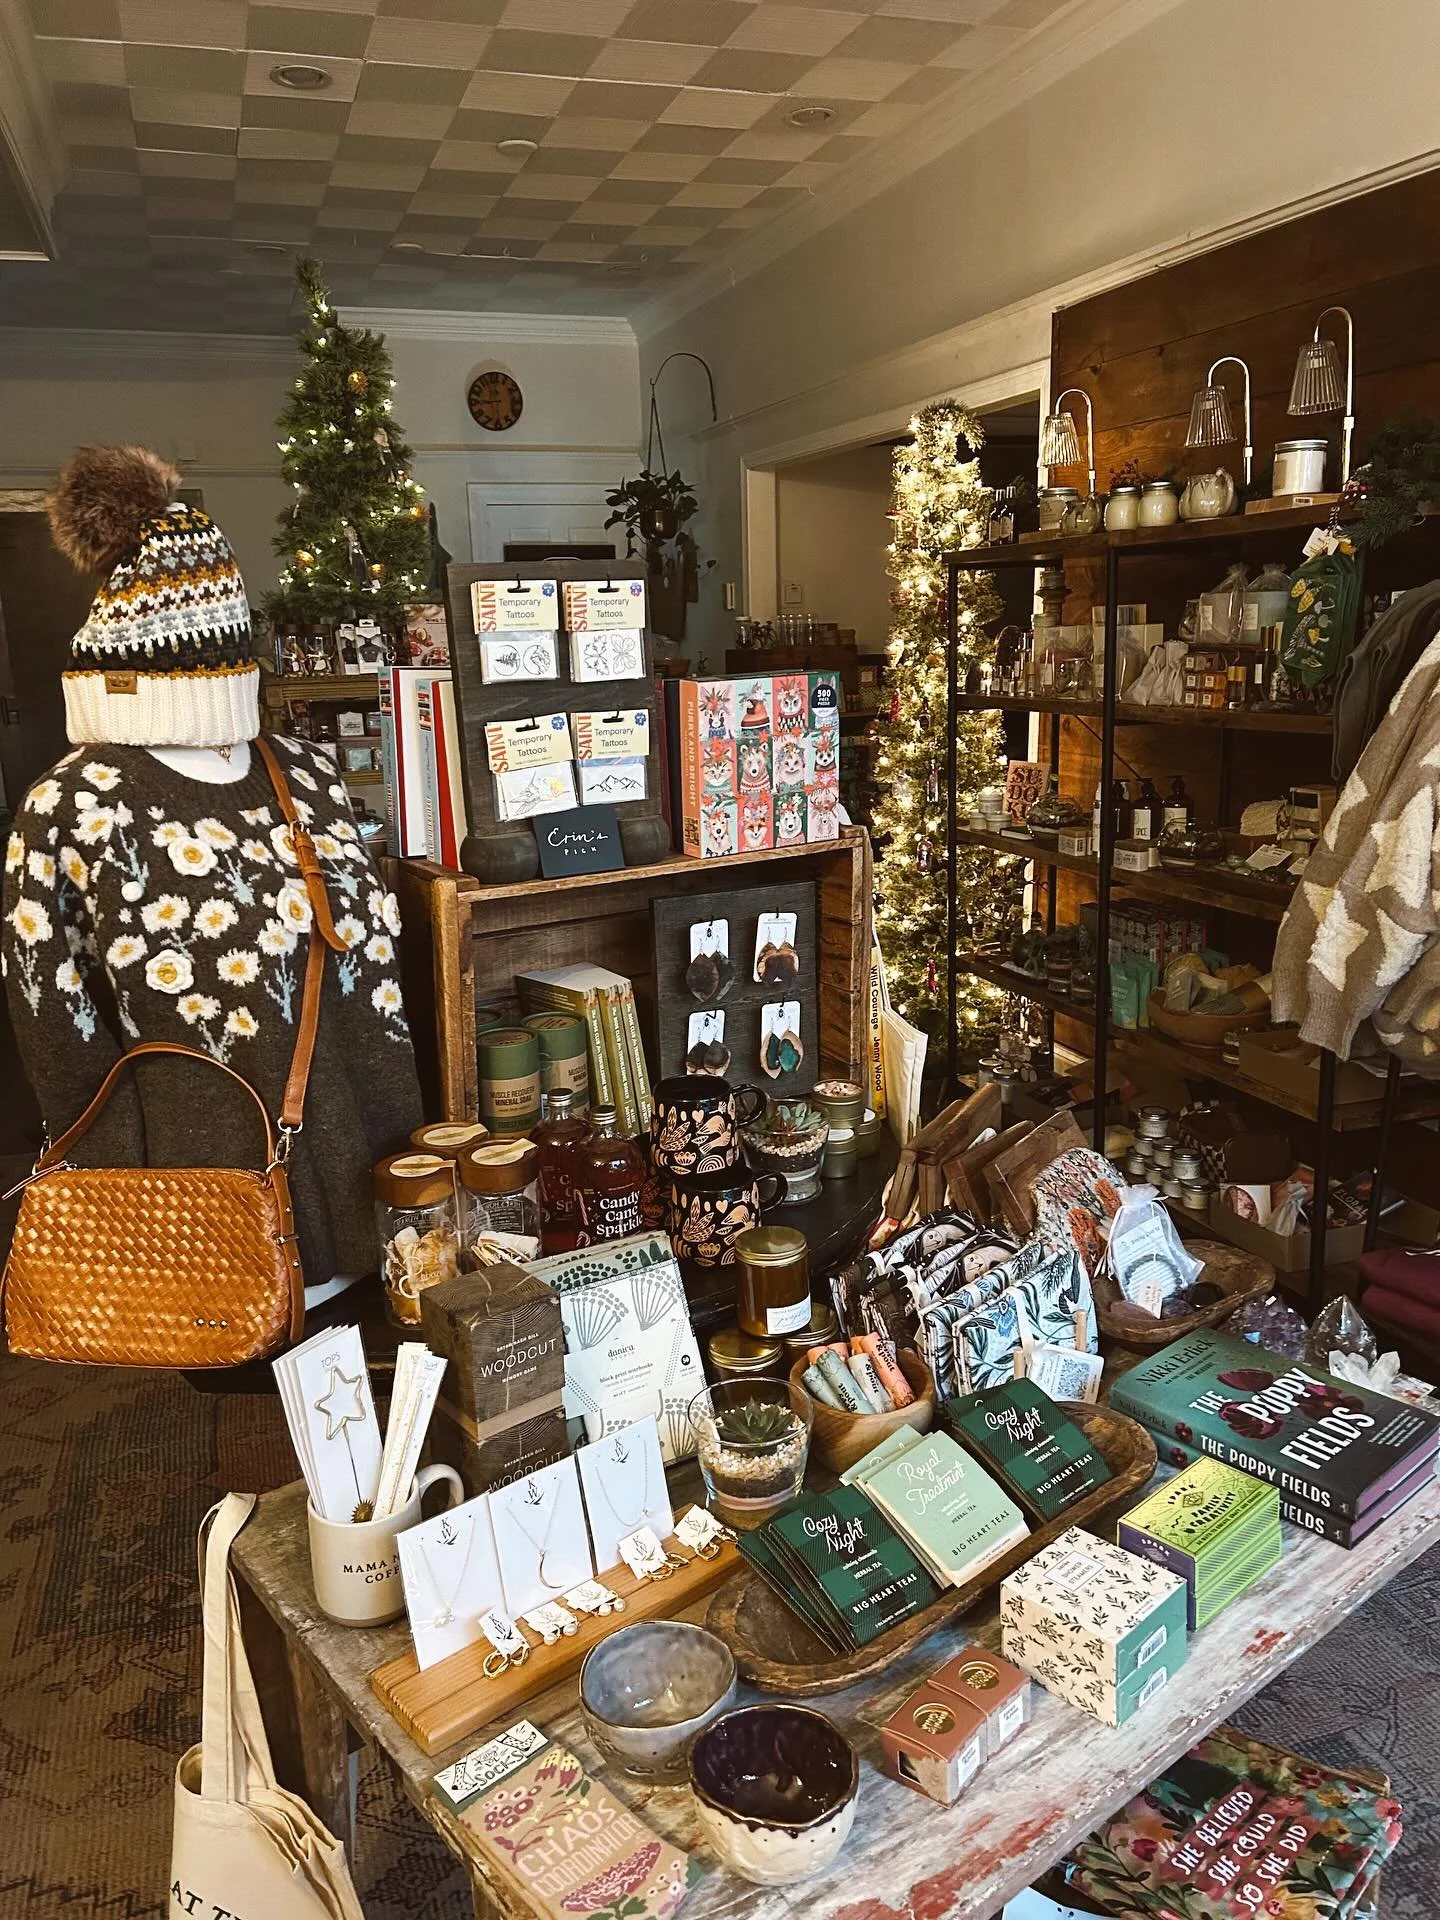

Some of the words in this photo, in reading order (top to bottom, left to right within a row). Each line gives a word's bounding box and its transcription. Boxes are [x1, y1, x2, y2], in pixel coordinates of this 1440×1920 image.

[480, 583, 497, 632] SAINT
[499, 598, 541, 608] Temporary
[572, 584, 588, 632] SAINT
[590, 597, 630, 607] Temporary
[506, 610, 534, 618] Tattoos
[596, 610, 623, 618] Tattoos
[817, 689, 831, 697] 500
[687, 701, 695, 737] FURRY
[508, 733, 552, 746] Temporary
[578, 715, 592, 760] SAINT
[594, 728, 634, 736] Temporary
[601, 739, 628, 747] Tattoos
[487, 725, 509, 774] SAINT
[517, 745, 547, 757] Tattoos
[548, 827, 608, 847] Erin's
[564, 846, 597, 855] PICK
[870, 964, 878, 987] Wild
[870, 988, 879, 1030] Courage
[873, 1036, 881, 1063] Jenny
[874, 1064, 883, 1092] Wood
[490, 1090, 511, 1099] MUSCLE
[511, 1086, 535, 1098] RECOVERY
[495, 1097, 519, 1106] MINERAL
[600, 1190, 640, 1210] Candy
[605, 1205, 639, 1222] Cane
[513, 1336, 527, 1345] NASH
[527, 1332, 539, 1340] GILL
[481, 1338, 556, 1378] WOODCUT
[608, 1344, 634, 1358] danica
[524, 1366, 537, 1375] GAME
[600, 1374, 614, 1383] block
[615, 1371, 628, 1380] print
[628, 1362, 653, 1374] notebooks
[1135, 1360, 1181, 1387] Nikki
[1169, 1339, 1217, 1364] Erlick
[1188, 1390, 1232, 1415] THE
[1237, 1367, 1327, 1424] POPPY
[985, 1406, 1018, 1430] Cozy
[1006, 1407, 1045, 1443] Night
[1280, 1406, 1376, 1470] FIELDS
[520, 1451, 534, 1460] NASH
[896, 1448, 943, 1483] Royal
[1035, 1451, 1053, 1464] HERBAL
[1051, 1445, 1061, 1455] TEA
[1036, 1482, 1052, 1494] BIG
[1051, 1466, 1075, 1485] HEART
[1074, 1454, 1093, 1470] TEAS
[1200, 1434, 1225, 1459] THE
[1229, 1448, 1277, 1481] POPPY
[1281, 1472, 1331, 1508] FIELDS
[527, 1479, 537, 1489] K
[905, 1460, 966, 1515] Treatment
[951, 1508, 968, 1524] HERBAL
[966, 1504, 978, 1514] TEA
[1189, 1491, 1236, 1528] CREATIVITY
[1191, 1495, 1222, 1518] FAMILY
[441, 1517, 450, 1529] K
[803, 1514, 839, 1537] Cozy
[951, 1543, 967, 1556] BIG
[967, 1524, 991, 1544] HEART
[991, 1510, 1010, 1526] TEAS
[825, 1517, 868, 1554] Night
[1141, 1538, 1170, 1557] SPARK
[343, 1559, 388, 1573] MAMA
[365, 1565, 400, 1583] COFF
[853, 1566, 872, 1580] HERBAL
[871, 1561, 883, 1571] TEA
[852, 1601, 870, 1614] BIG
[870, 1584, 897, 1605] HEART
[896, 1573, 918, 1589] TEAS
[474, 1750, 524, 1787] SOCKS
[516, 1797, 616, 1878] CHAOS
[1170, 1843, 1204, 1876] SHE
[1195, 1790, 1255, 1846] BELIEVED
[531, 1812, 643, 1897] COORDINATOR
[1207, 1855, 1241, 1887] SHE
[1232, 1812, 1277, 1859] COULD
[1235, 1883, 1264, 1913] SO
[1255, 1854, 1290, 1885] SHE
[1282, 1824, 1309, 1853] DID
